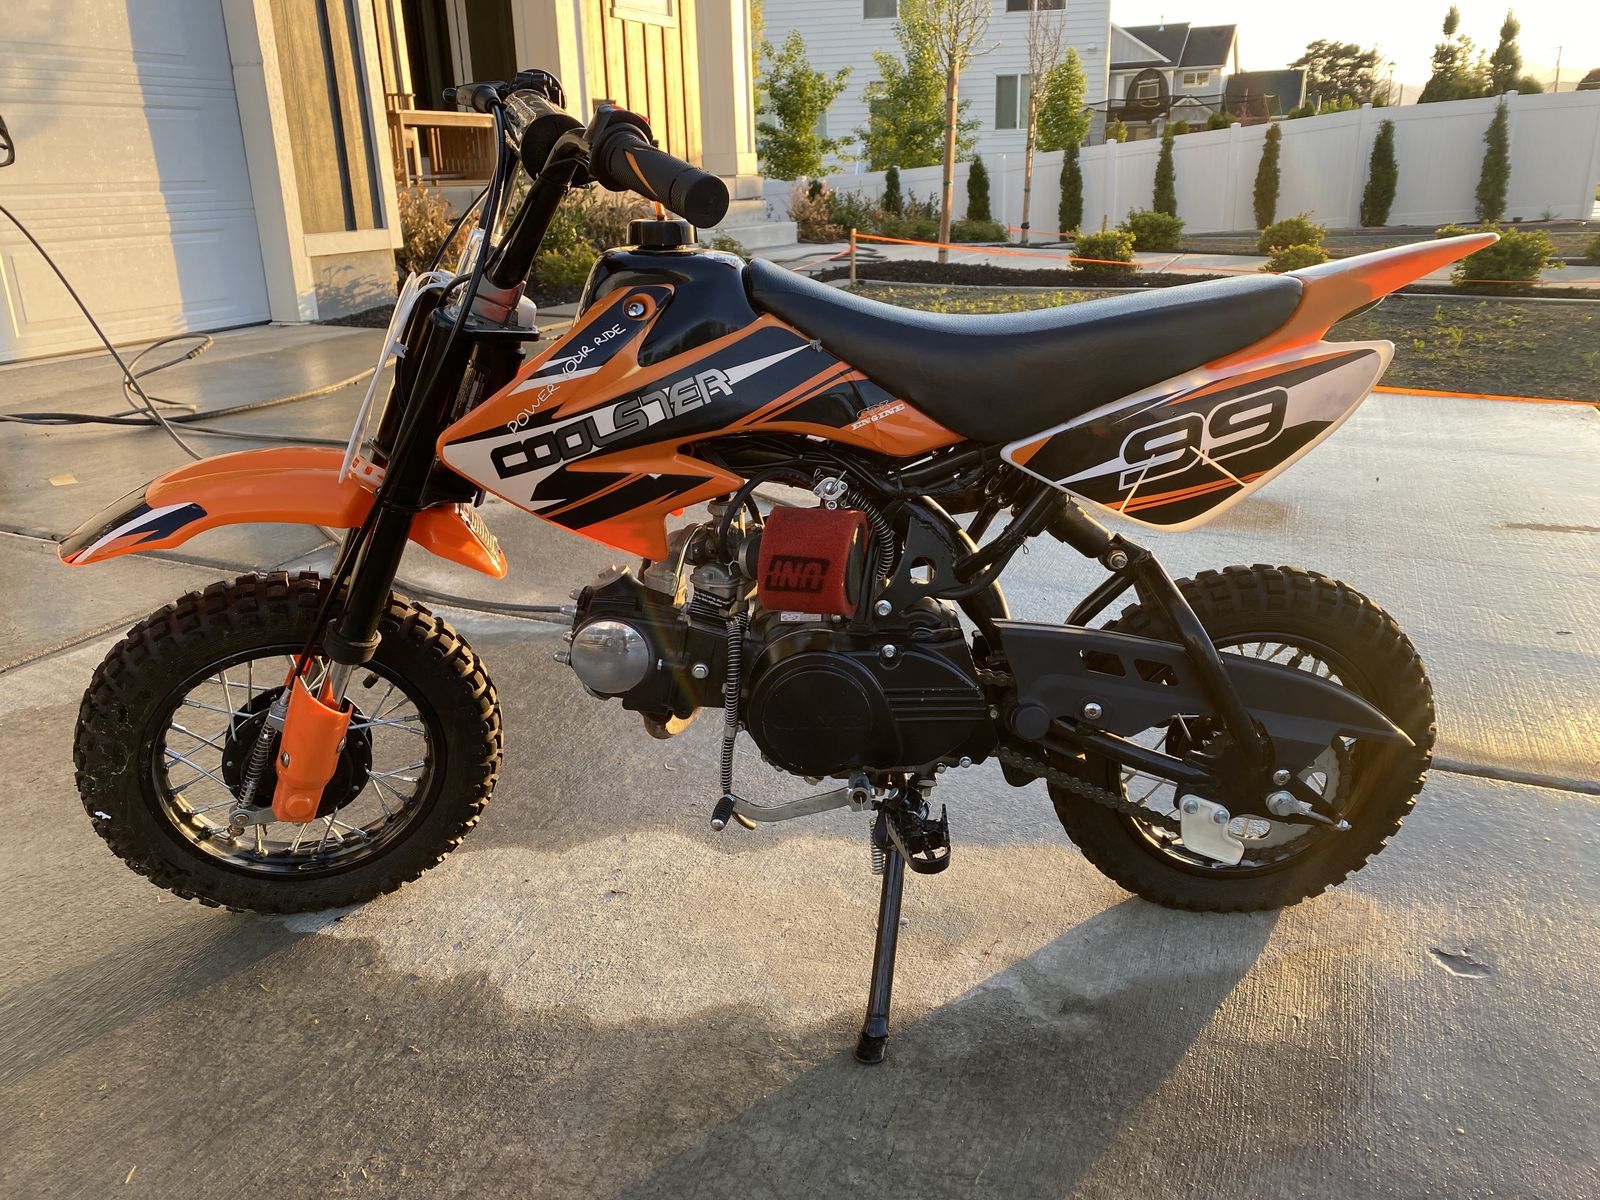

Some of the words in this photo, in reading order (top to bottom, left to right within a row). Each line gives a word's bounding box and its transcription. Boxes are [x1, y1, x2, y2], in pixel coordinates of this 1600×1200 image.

[491, 369, 733, 479] COOLSTER
[507, 384, 560, 434] POWER
[561, 345, 595, 379] YOUR
[594, 323, 627, 346] RIDE
[851, 403, 906, 431] ENGINE
[1119, 386, 1288, 490] 99
